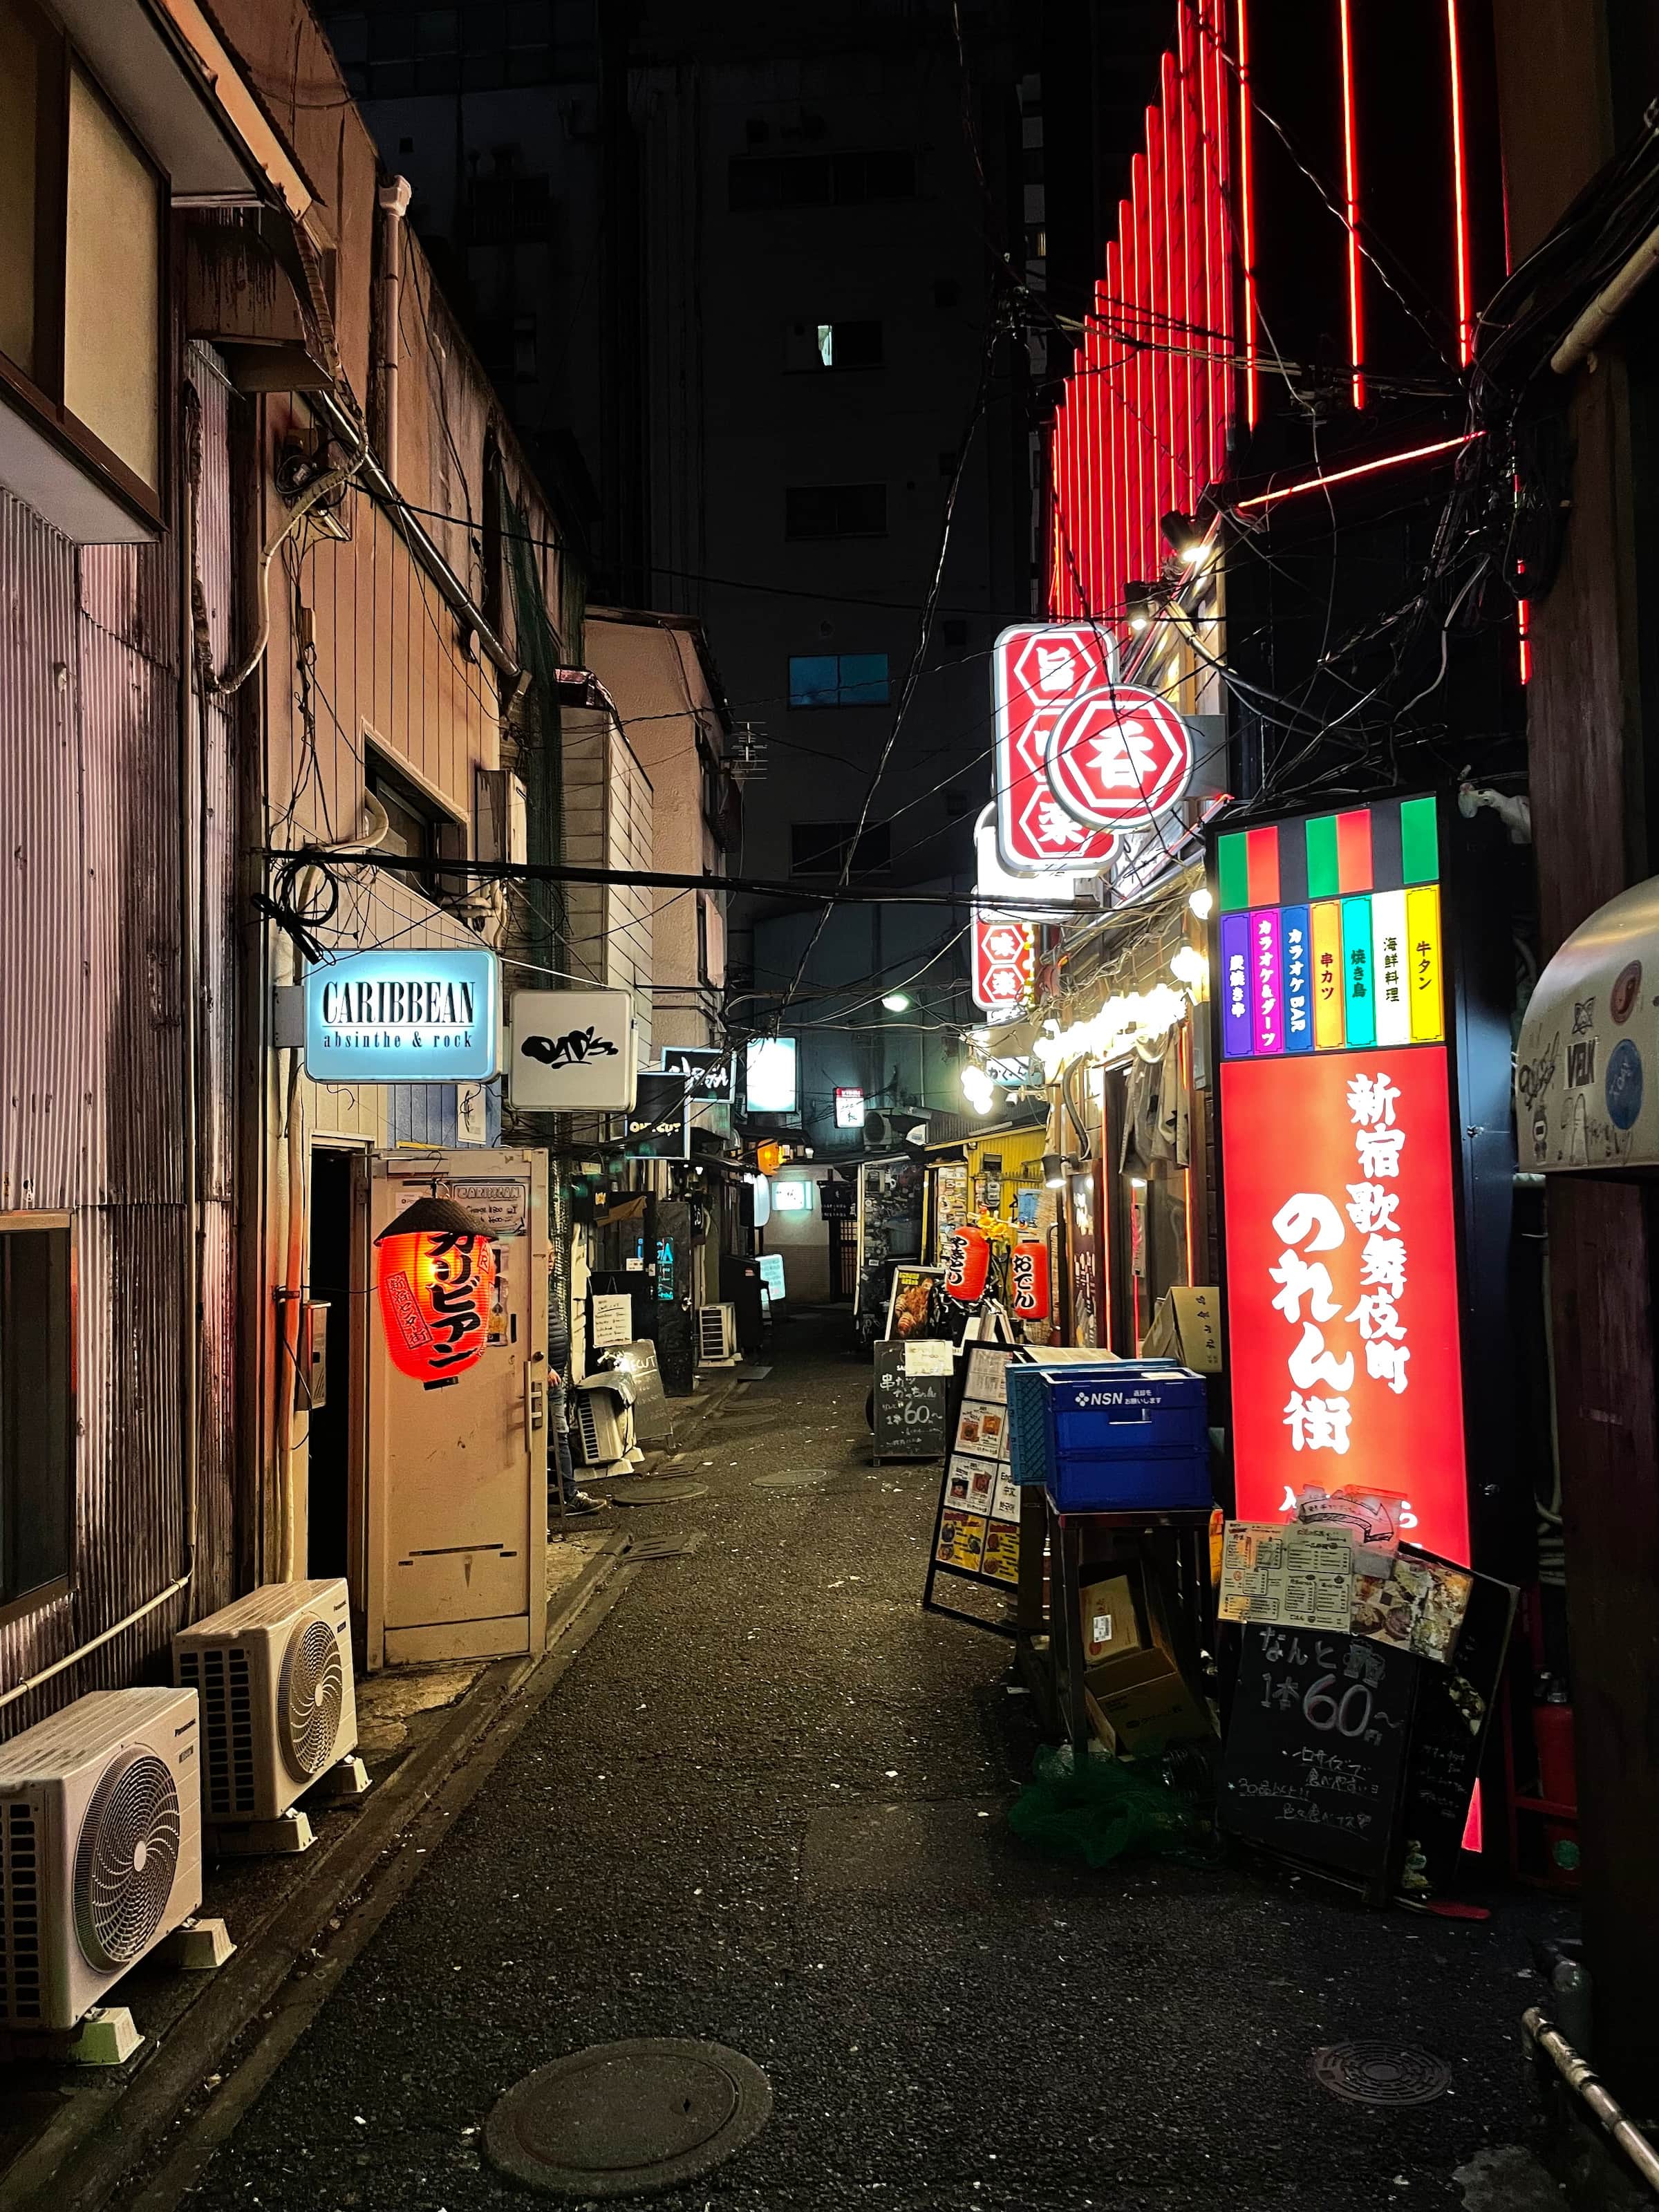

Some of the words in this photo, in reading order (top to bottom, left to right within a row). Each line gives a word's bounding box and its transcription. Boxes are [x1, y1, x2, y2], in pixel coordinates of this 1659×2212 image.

[1320, 953, 1334, 1000] 串カツ
[1351, 948, 1367, 998] 焼き鳥
[1383, 937, 1400, 1002] 海鮮料理
[1416, 941, 1432, 990] 牛タン
[322, 981, 476, 1024] CARIBBEAN
[324, 1031, 401, 1048] absinthe
[413, 1031, 422, 1048] &
[433, 1031, 472, 1048] rock
[1344, 1071, 1411, 1394] 新宿歌舞伎町
[948, 1235, 968, 1285] やきとり
[1013, 1255, 1035, 1309] おでん
[424, 1232, 482, 1369] カリビアン
[1268, 1192, 1355, 1455] のれん街
[1090, 1392, 1123, 1405] NSN
[1259, 1626, 1338, 1670] なんと
